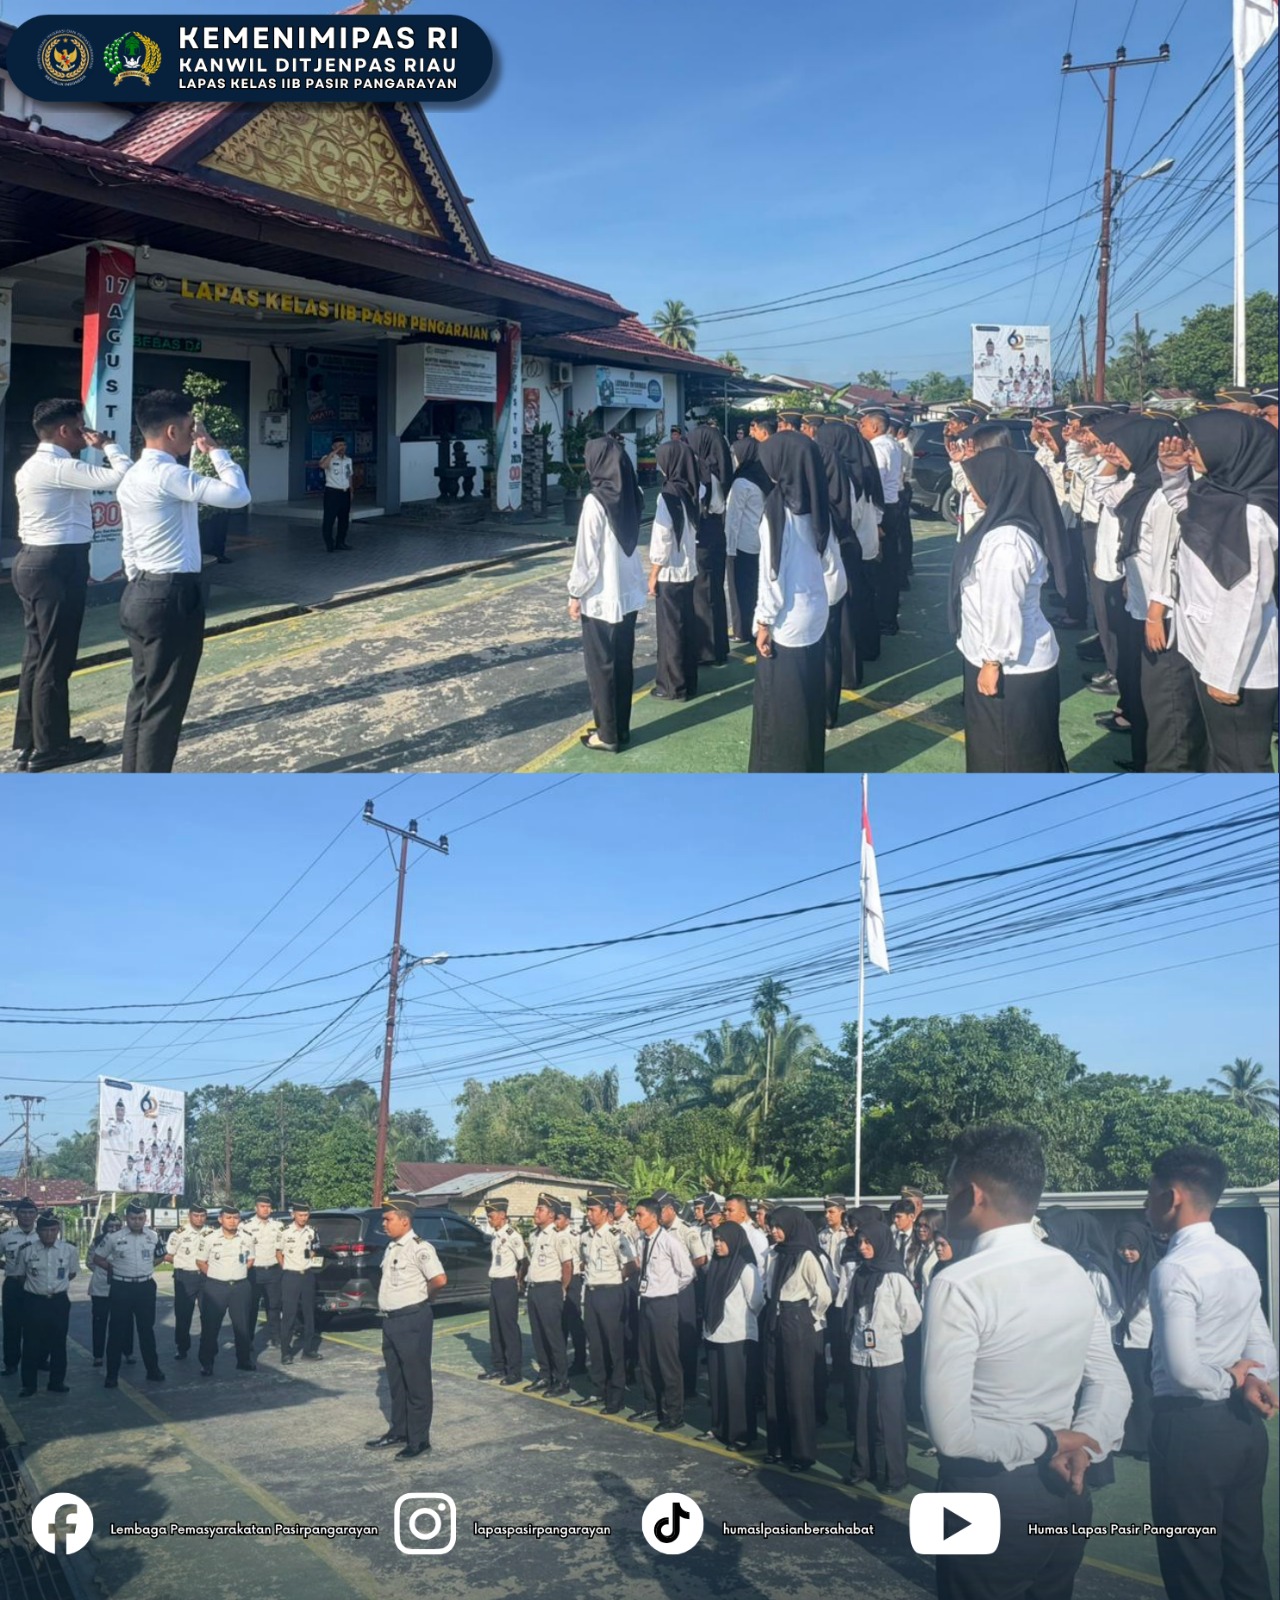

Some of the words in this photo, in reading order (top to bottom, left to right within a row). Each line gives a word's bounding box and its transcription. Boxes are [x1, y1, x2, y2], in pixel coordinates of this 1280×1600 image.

[105, 275, 129, 295] 17
[181, 277, 259, 308] LAPAS
[265, 291, 330, 318] KELAS
[334, 302, 357, 322] IIB
[361, 307, 406, 329] PASIR
[410, 315, 489, 341] PENGARAIAN
[134, 335, 181, 351] BEBAS
